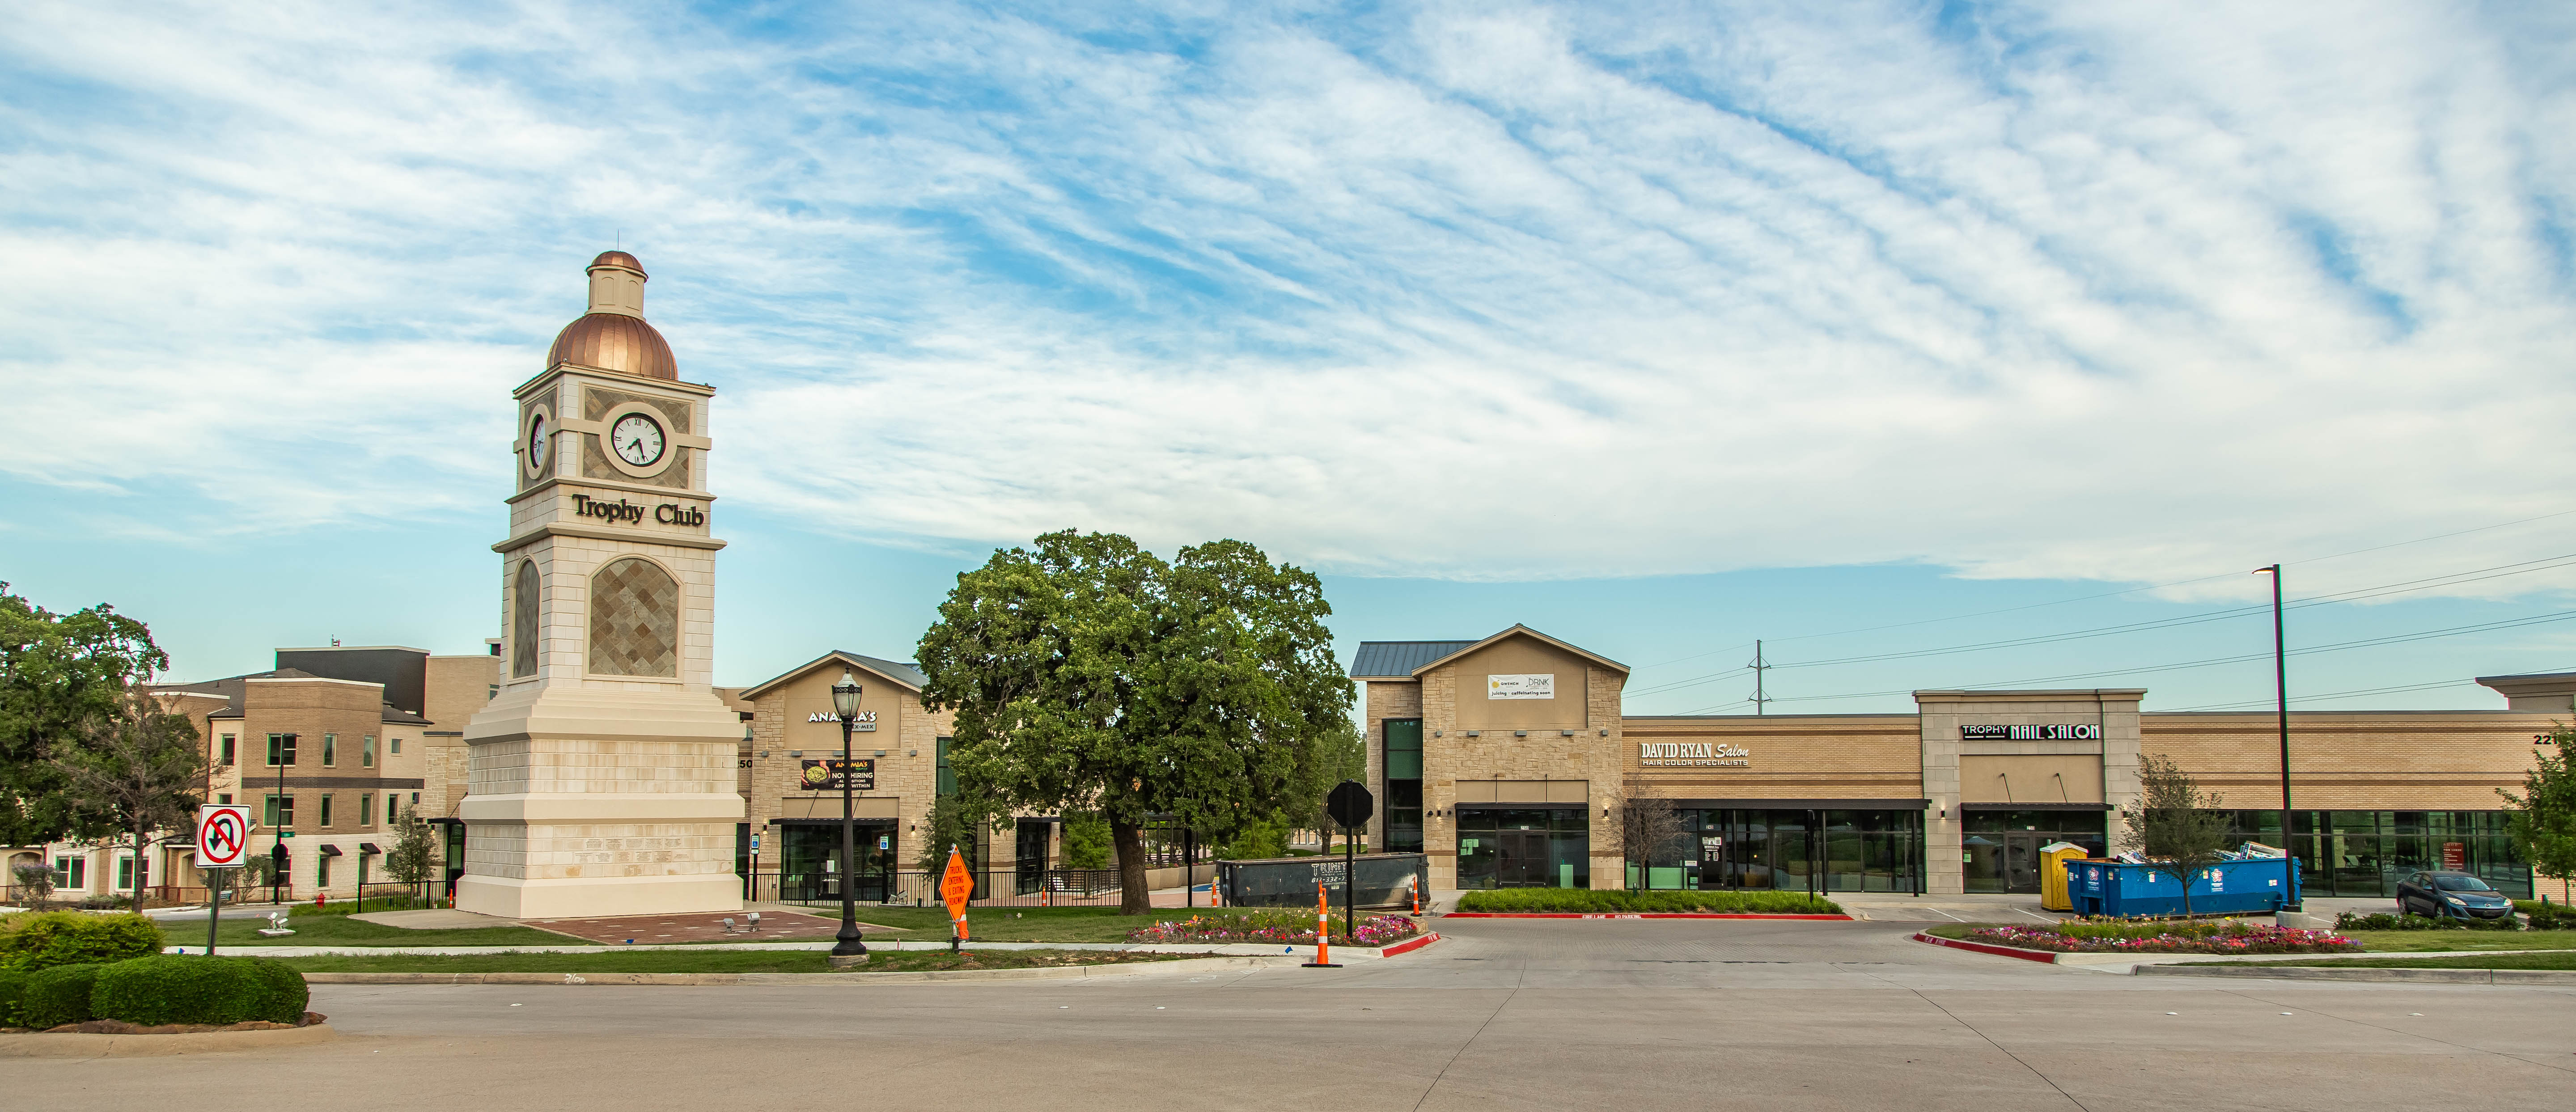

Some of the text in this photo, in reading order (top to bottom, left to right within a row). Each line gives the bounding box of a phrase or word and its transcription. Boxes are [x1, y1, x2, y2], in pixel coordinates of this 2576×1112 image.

[572, 494, 705, 526] Trophy Club
[2010, 725, 2045, 739] NAIL
[2047, 725, 2100, 739] SALON
[1641, 743, 1750, 758] DAVID RYAN Salon
[738, 760, 753, 768] 50
[950, 866, 962, 874] TRUCKS
[949, 875, 964, 885] ENTERING
[953, 886, 964, 895] EXITING
[949, 896, 964, 905] ROADWAY
